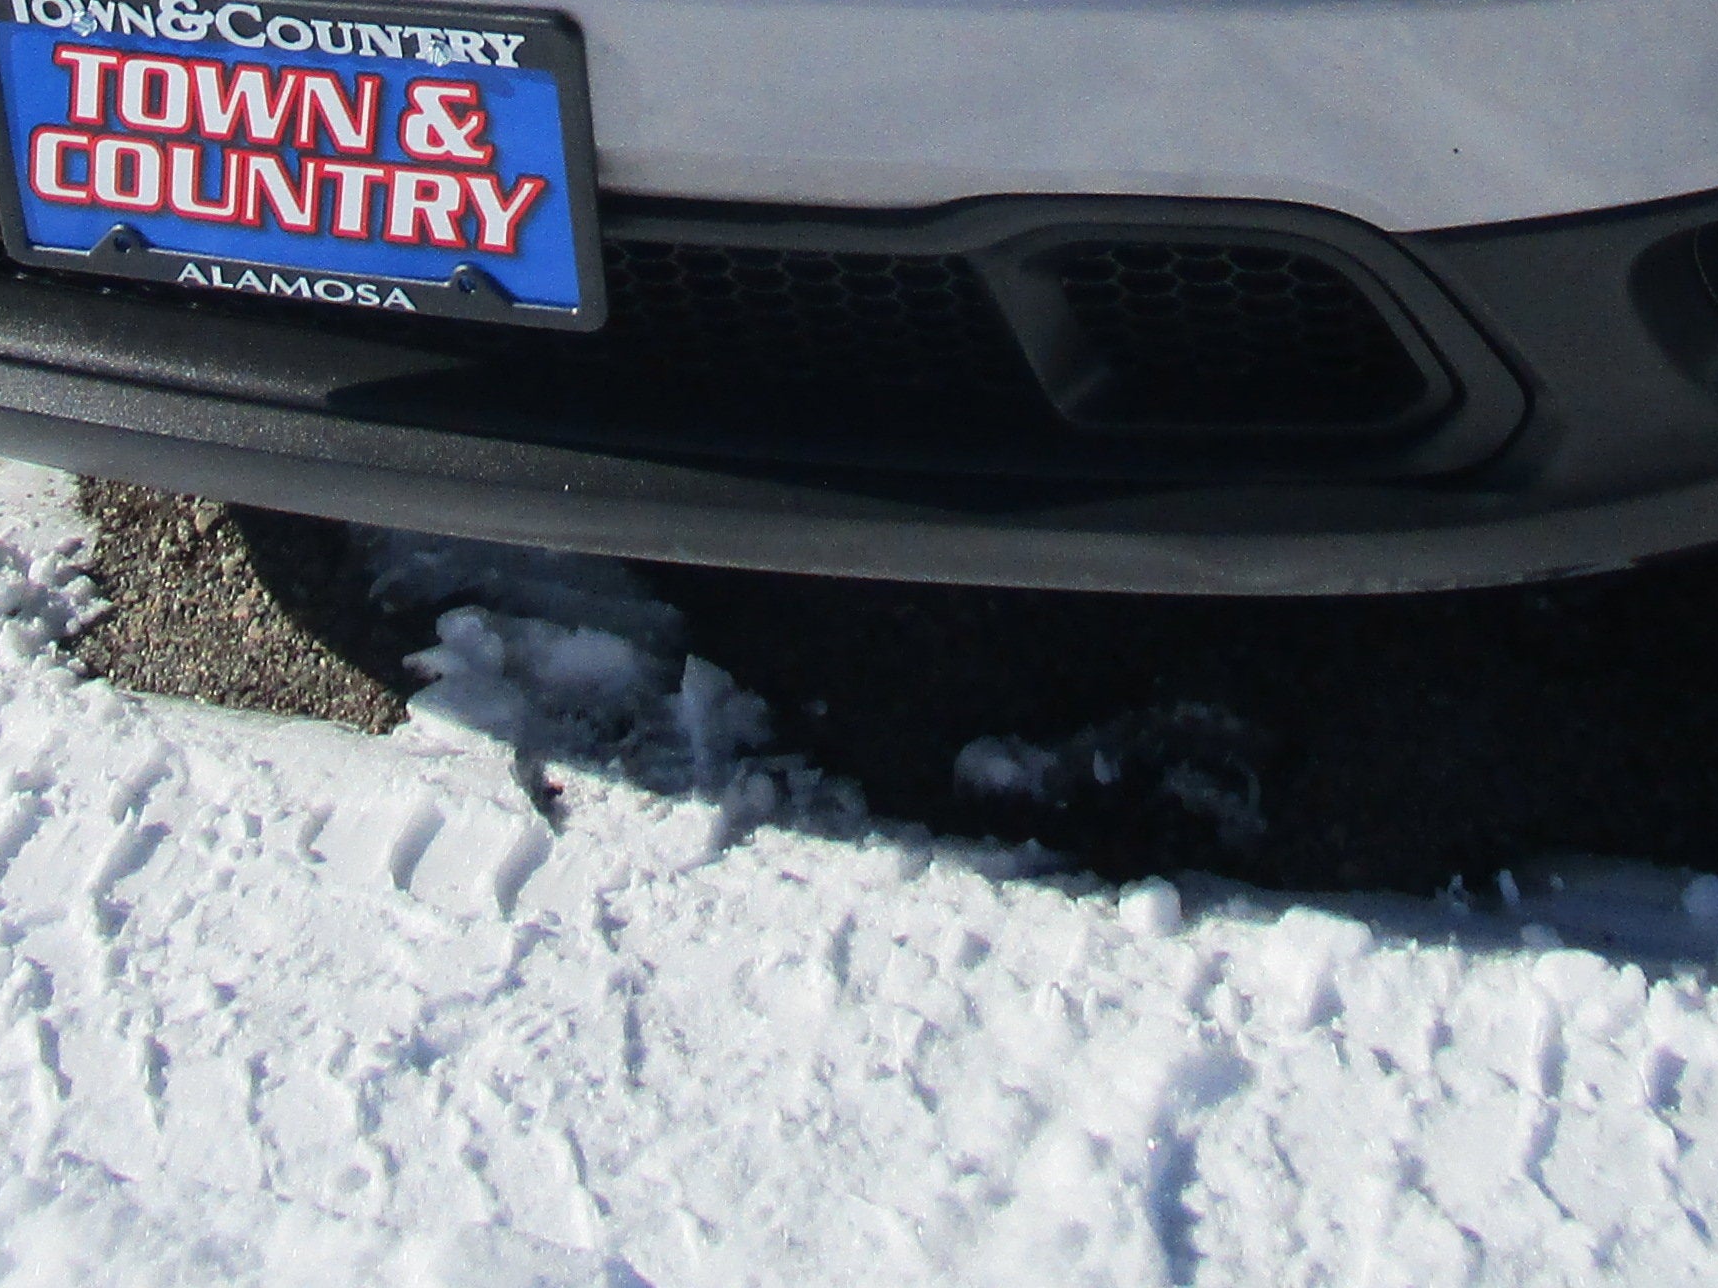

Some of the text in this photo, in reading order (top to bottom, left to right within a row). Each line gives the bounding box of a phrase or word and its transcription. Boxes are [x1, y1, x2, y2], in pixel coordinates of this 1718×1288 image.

[55, 43, 494, 165] TOWN &
[29, 126, 545, 254] COUNTRY
[175, 261, 419, 313] ALAMOSA
